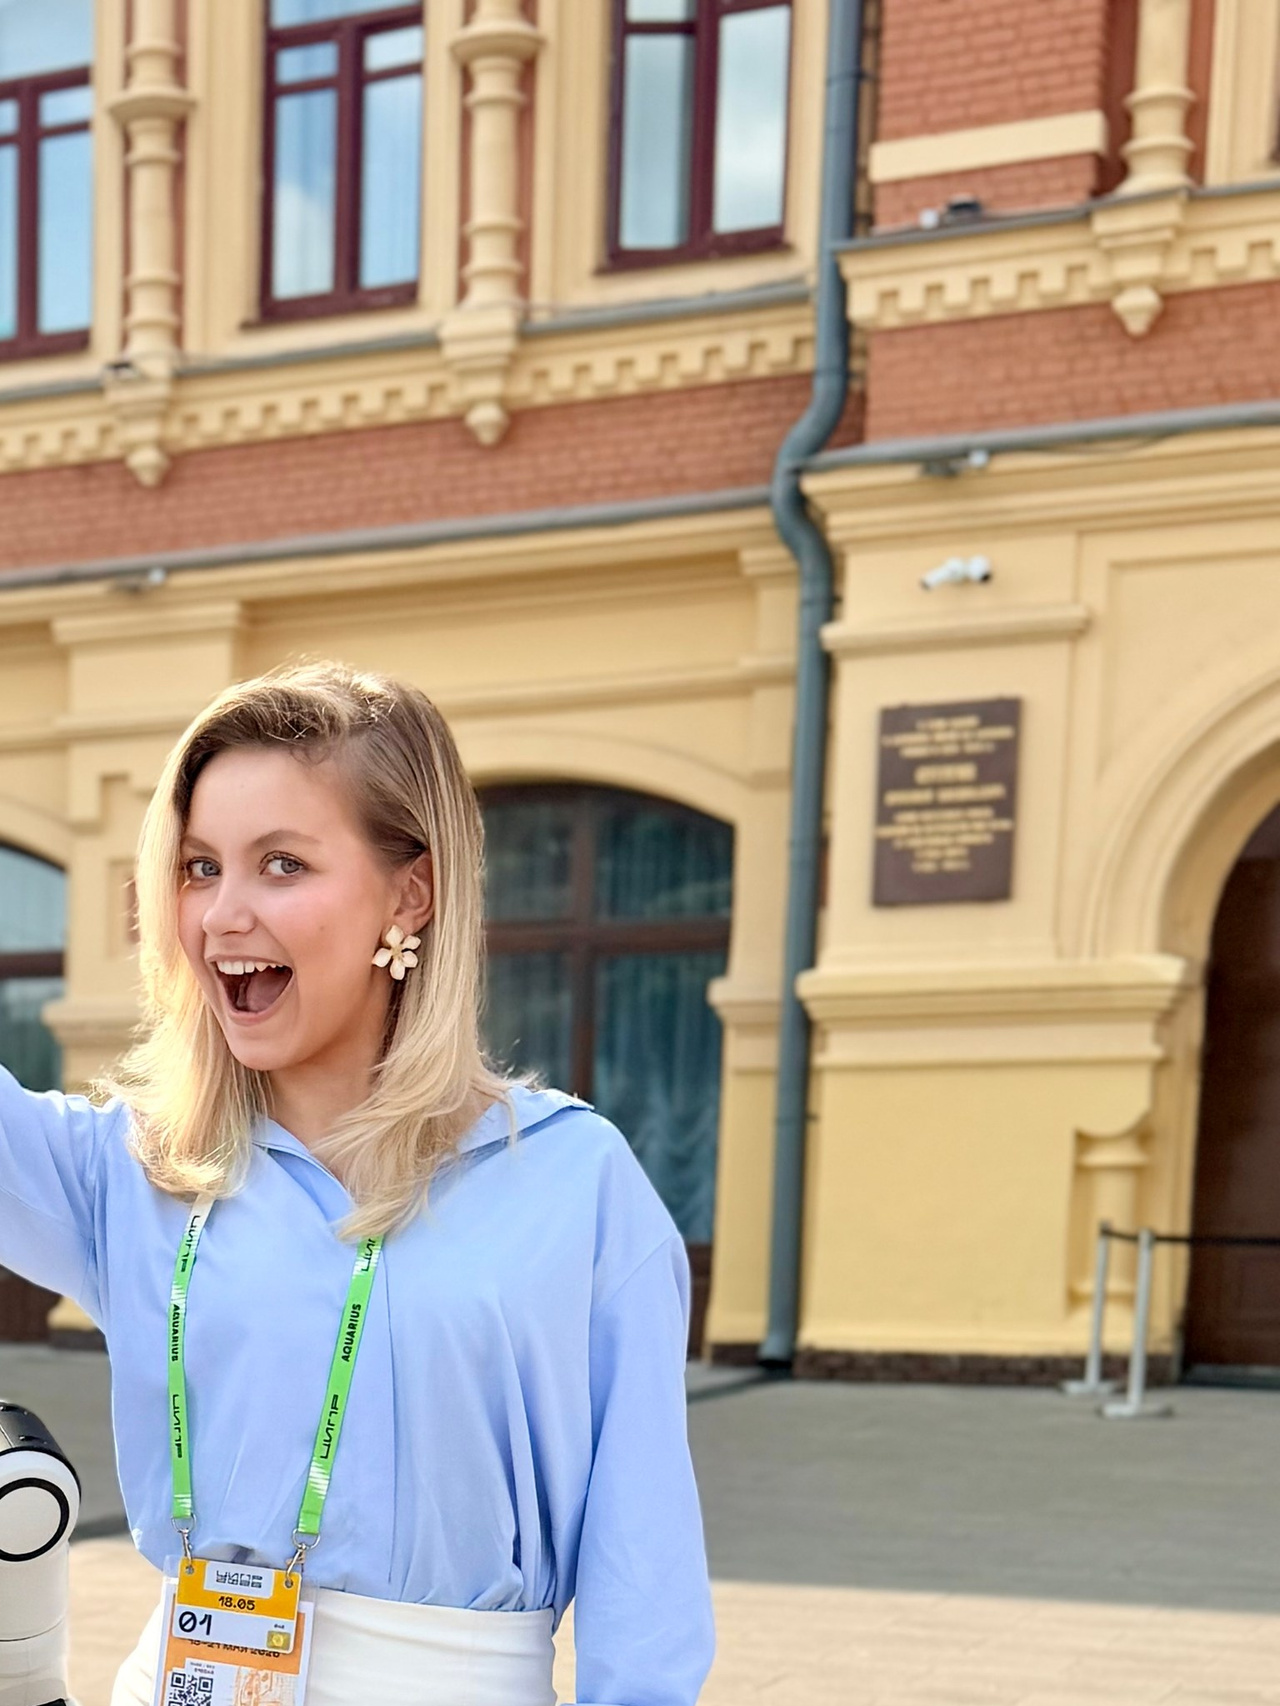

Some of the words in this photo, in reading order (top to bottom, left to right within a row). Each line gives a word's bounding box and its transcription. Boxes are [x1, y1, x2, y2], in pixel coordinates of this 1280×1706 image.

[171, 1304, 181, 1362] AQUARIUS
[341, 1303, 362, 1362] AQUARIUS
[178, 1611, 212, 1636] 01
[218, 1596, 255, 1611] 18.05
